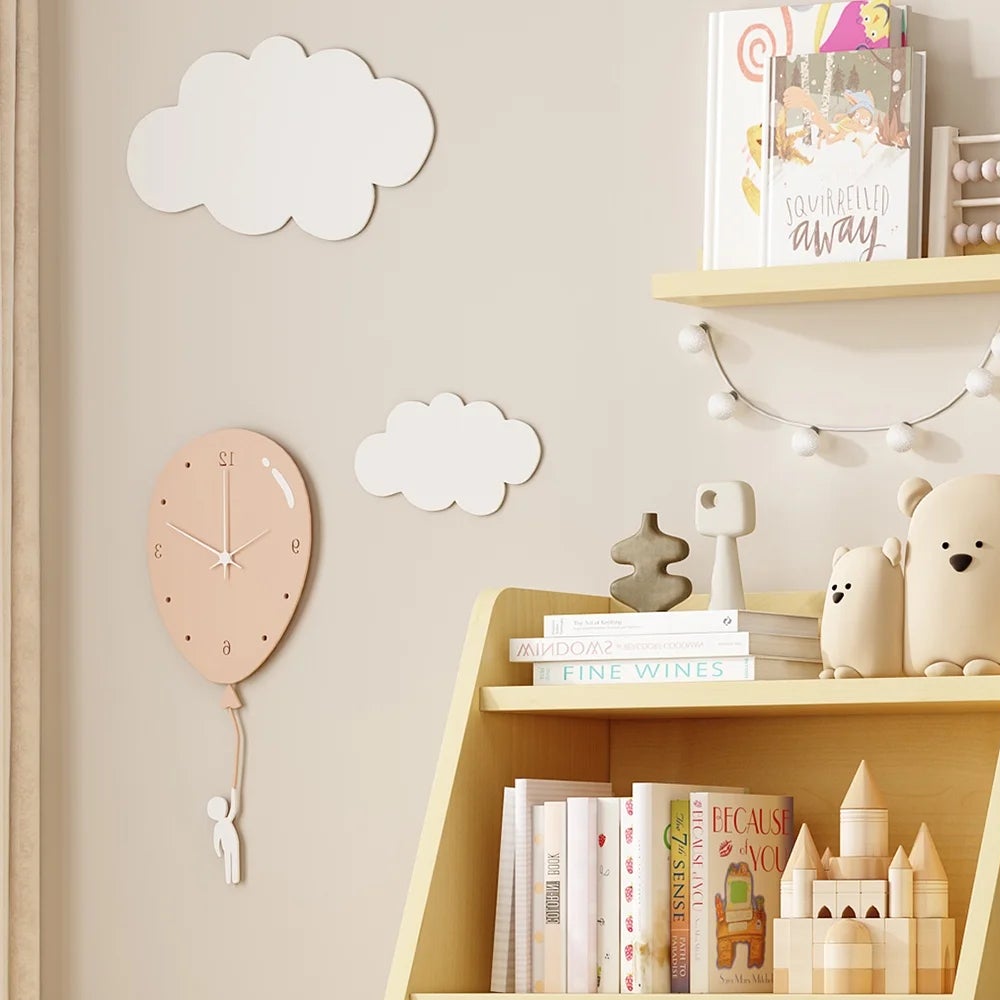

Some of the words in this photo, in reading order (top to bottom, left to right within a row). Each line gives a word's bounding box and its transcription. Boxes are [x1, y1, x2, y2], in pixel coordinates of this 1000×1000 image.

[786, 184, 889, 226] SQUIRRELLED
[788, 215, 887, 262] away
[563, 664, 621, 681] FINE
[634, 661, 724, 679] WINES
[712, 806, 790, 836] BECAUSE
[739, 838, 748, 855] of
[749, 845, 788, 873] YOU
[672, 860, 686, 922] SENSE
